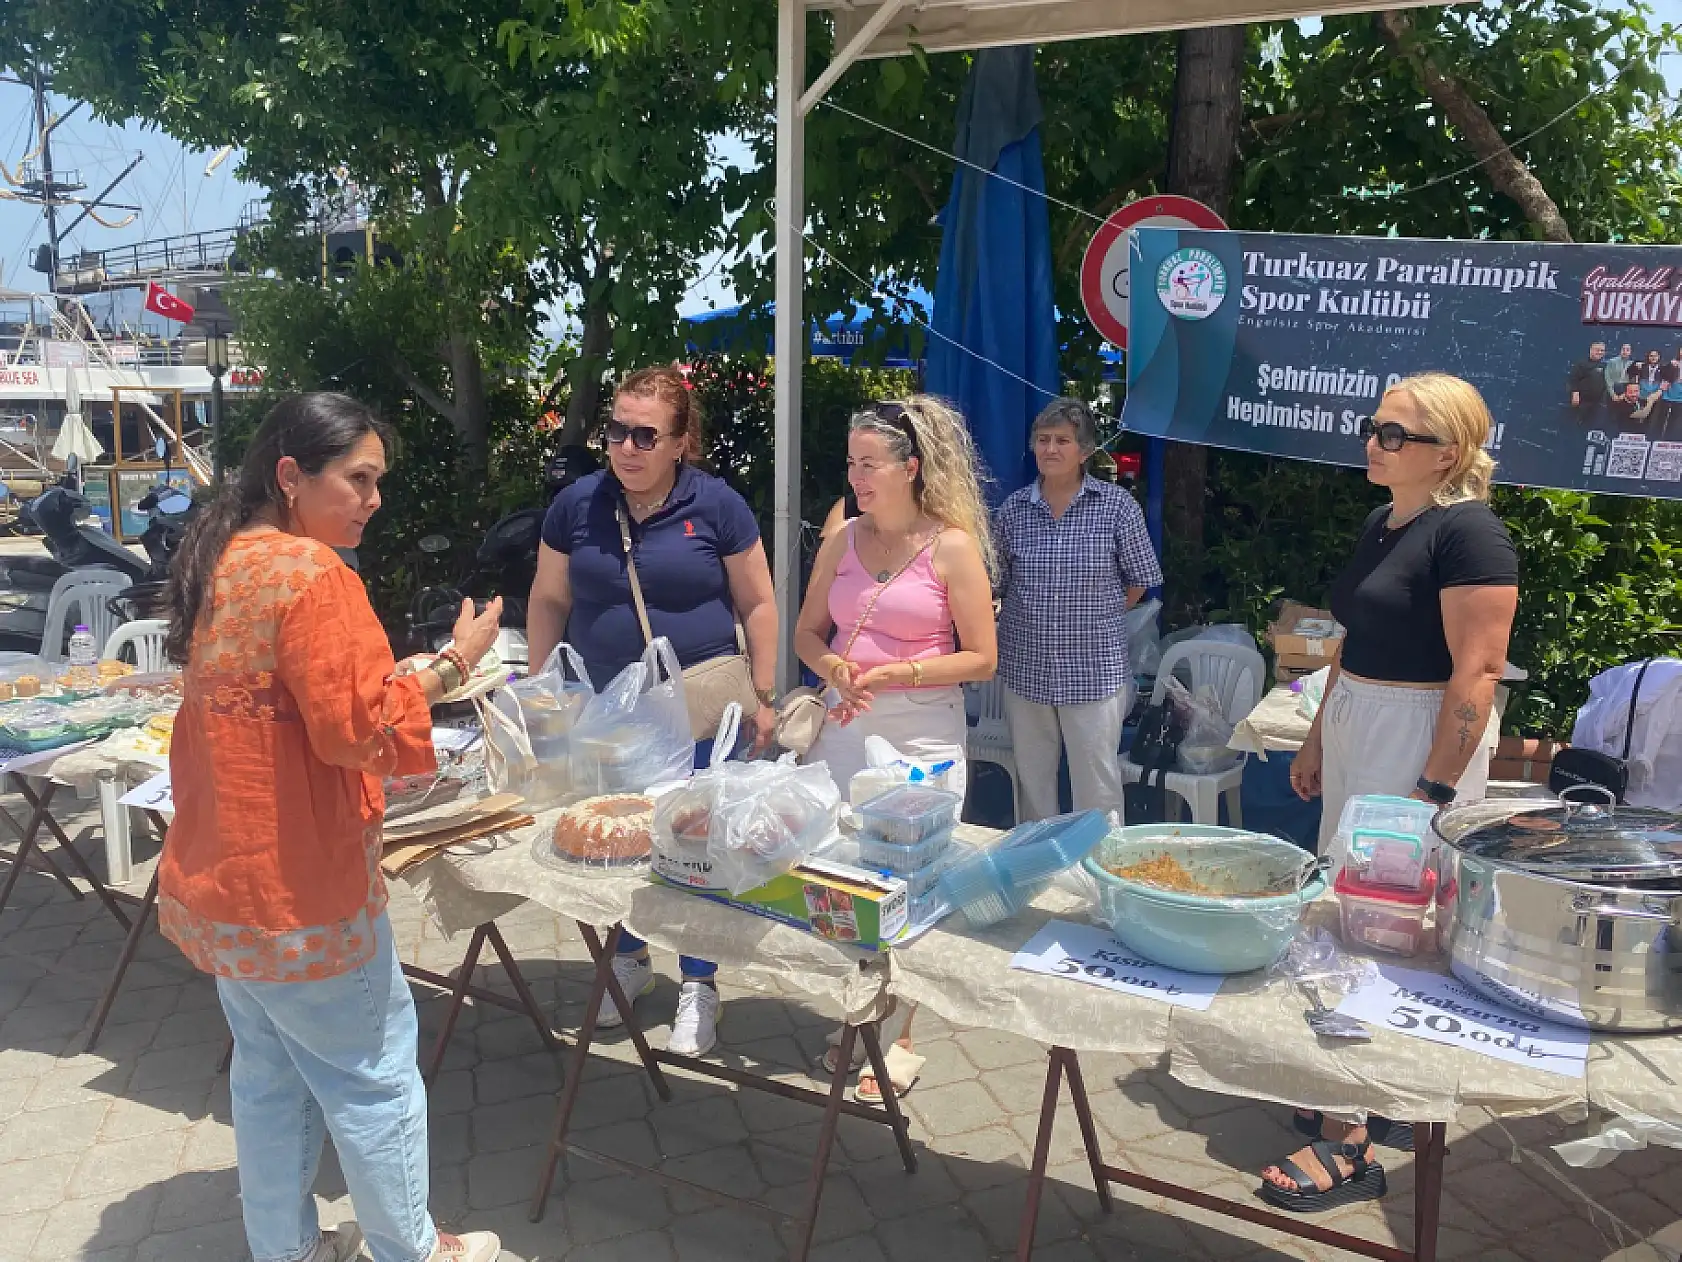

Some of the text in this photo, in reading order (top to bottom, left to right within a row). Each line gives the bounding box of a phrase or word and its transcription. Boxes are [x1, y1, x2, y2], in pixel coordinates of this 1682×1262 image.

[1243, 251, 1560, 293] Turkuaz Paralimpik
[1240, 284, 1431, 319] Spor Kulübü
[1238, 314, 1299, 329] Engelsiz
[1307, 318, 1340, 332] Spor
[1257, 362, 1379, 398] Şehrimizin
[1227, 394, 1336, 433] Hepimisin
[1390, 987, 1541, 1033] Makarna
